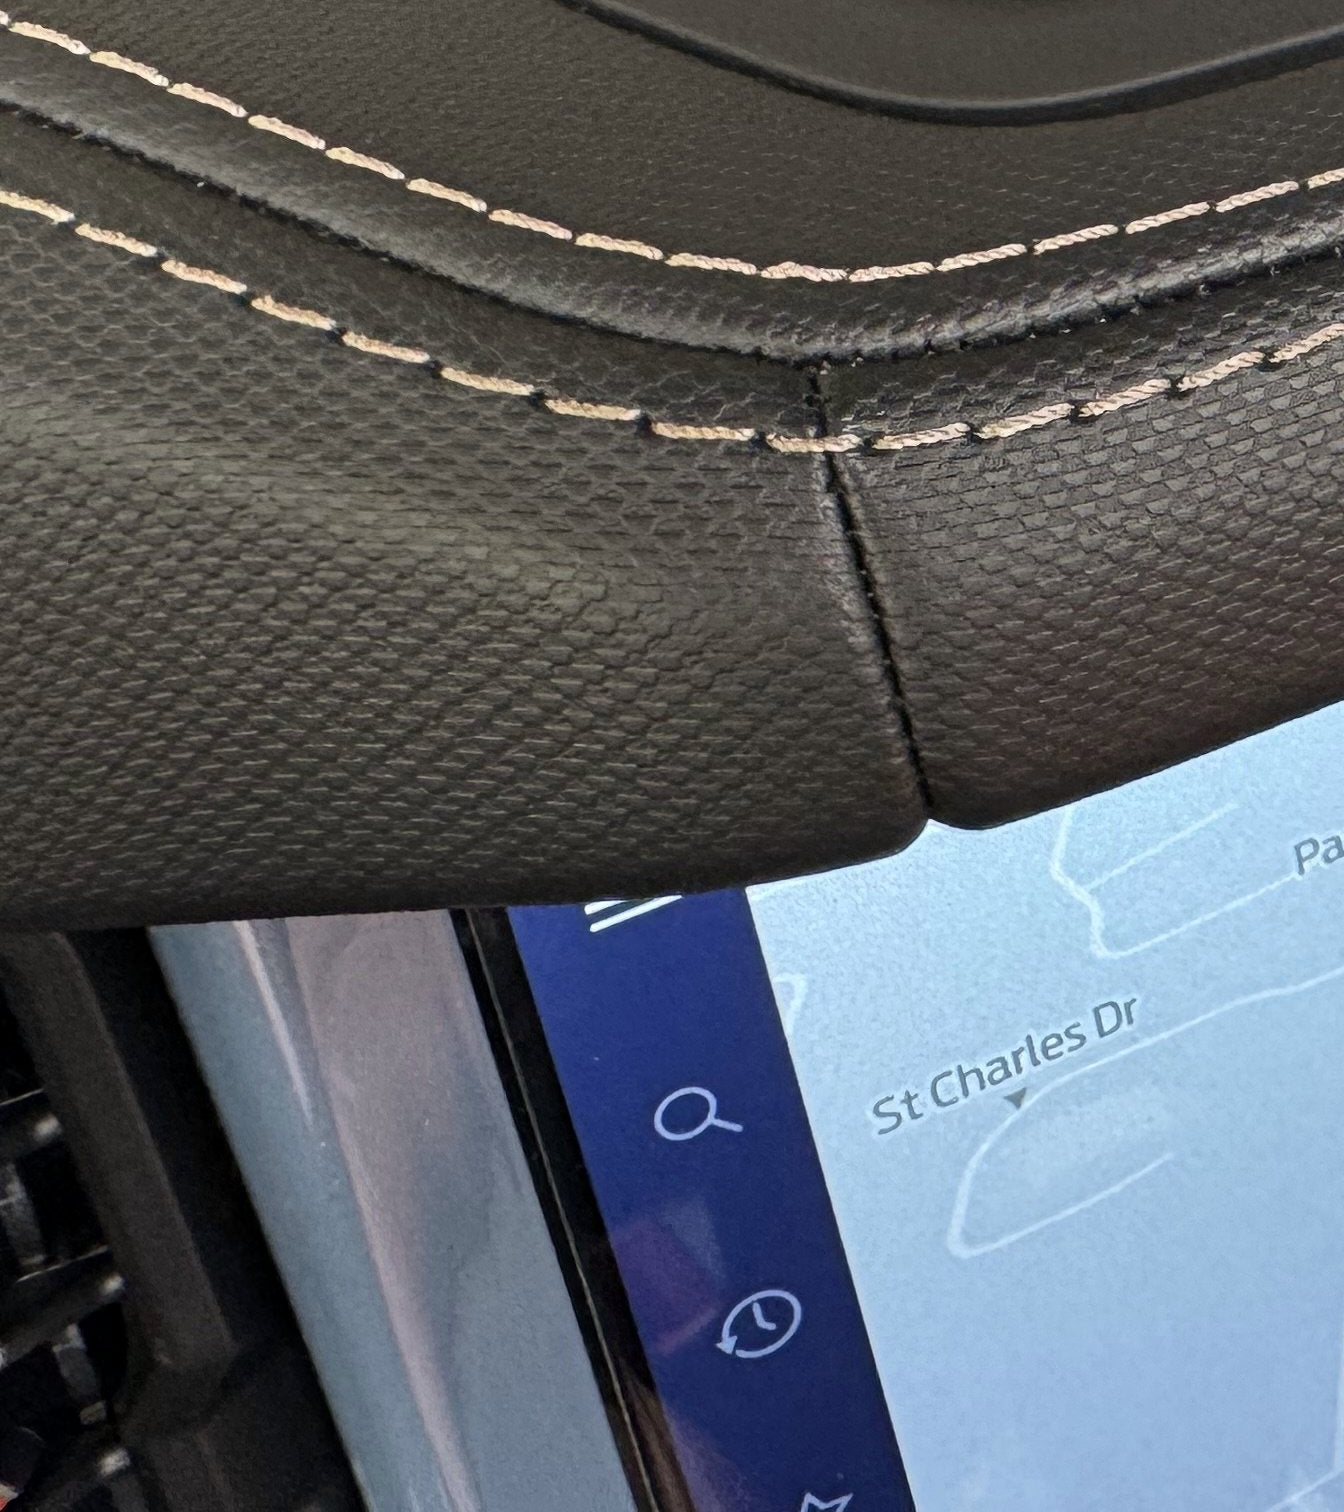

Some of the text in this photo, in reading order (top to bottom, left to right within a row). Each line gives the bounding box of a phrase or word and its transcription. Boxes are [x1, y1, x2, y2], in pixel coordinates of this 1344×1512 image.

[873, 997, 1137, 1135] St Charles Dr
